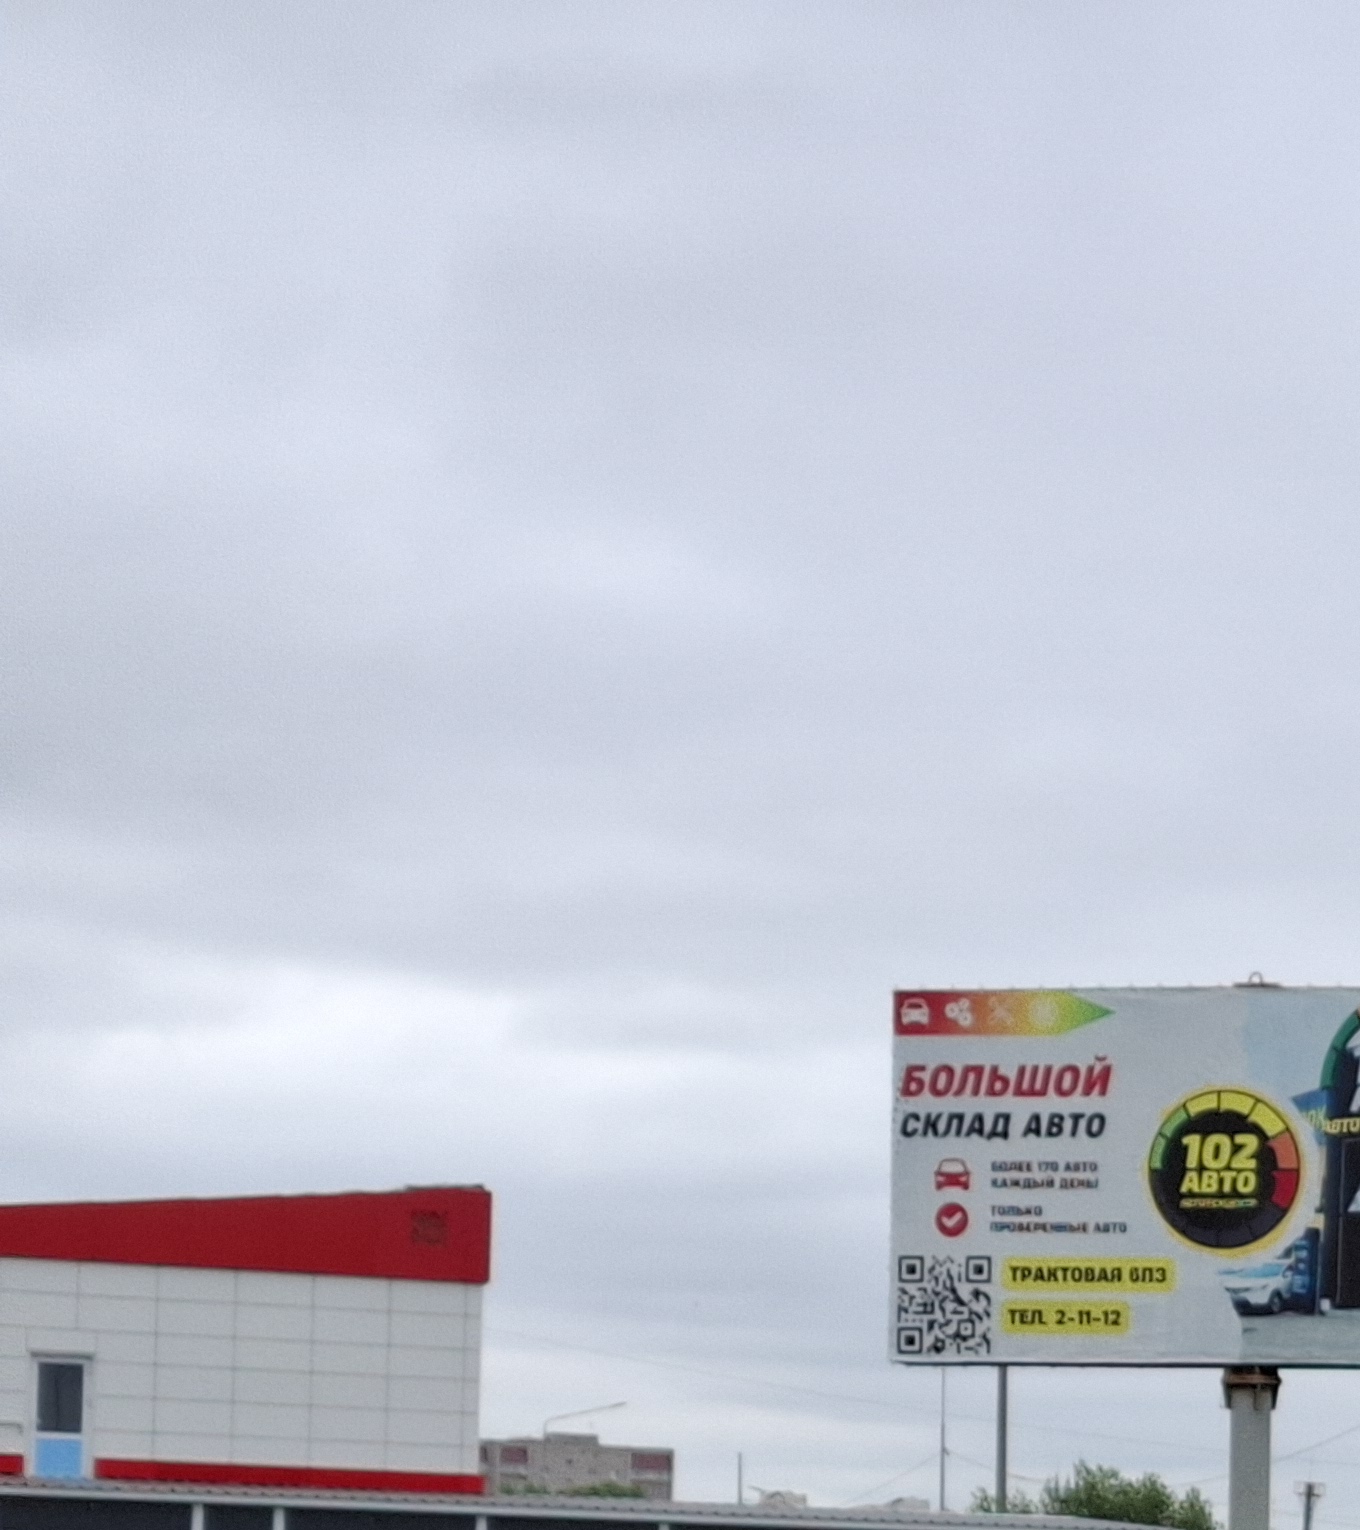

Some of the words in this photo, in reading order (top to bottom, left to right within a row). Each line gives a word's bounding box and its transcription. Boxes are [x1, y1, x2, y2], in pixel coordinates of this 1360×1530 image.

[900, 1055, 1113, 1098] БОЛЬШОЙ
[900, 1111, 1011, 1141] СКЛАД
[1021, 1111, 1106, 1139] АВТО
[1181, 1133, 1259, 1169] 102
[1064, 1161, 1098, 1172] АВТО
[991, 1176, 1055, 1189] КАЖДЫЙ
[1179, 1169, 1257, 1194] АВТО
[991, 1205, 1043, 1216] ТОЛЬКО
[1093, 1222, 1128, 1233] АВТО
[1009, 1266, 1123, 1283] ТРАКТОВАЯ
[1008, 1309, 1047, 1325] ТЕЛ.
[1055, 1309, 1122, 1326] 2-11-12
